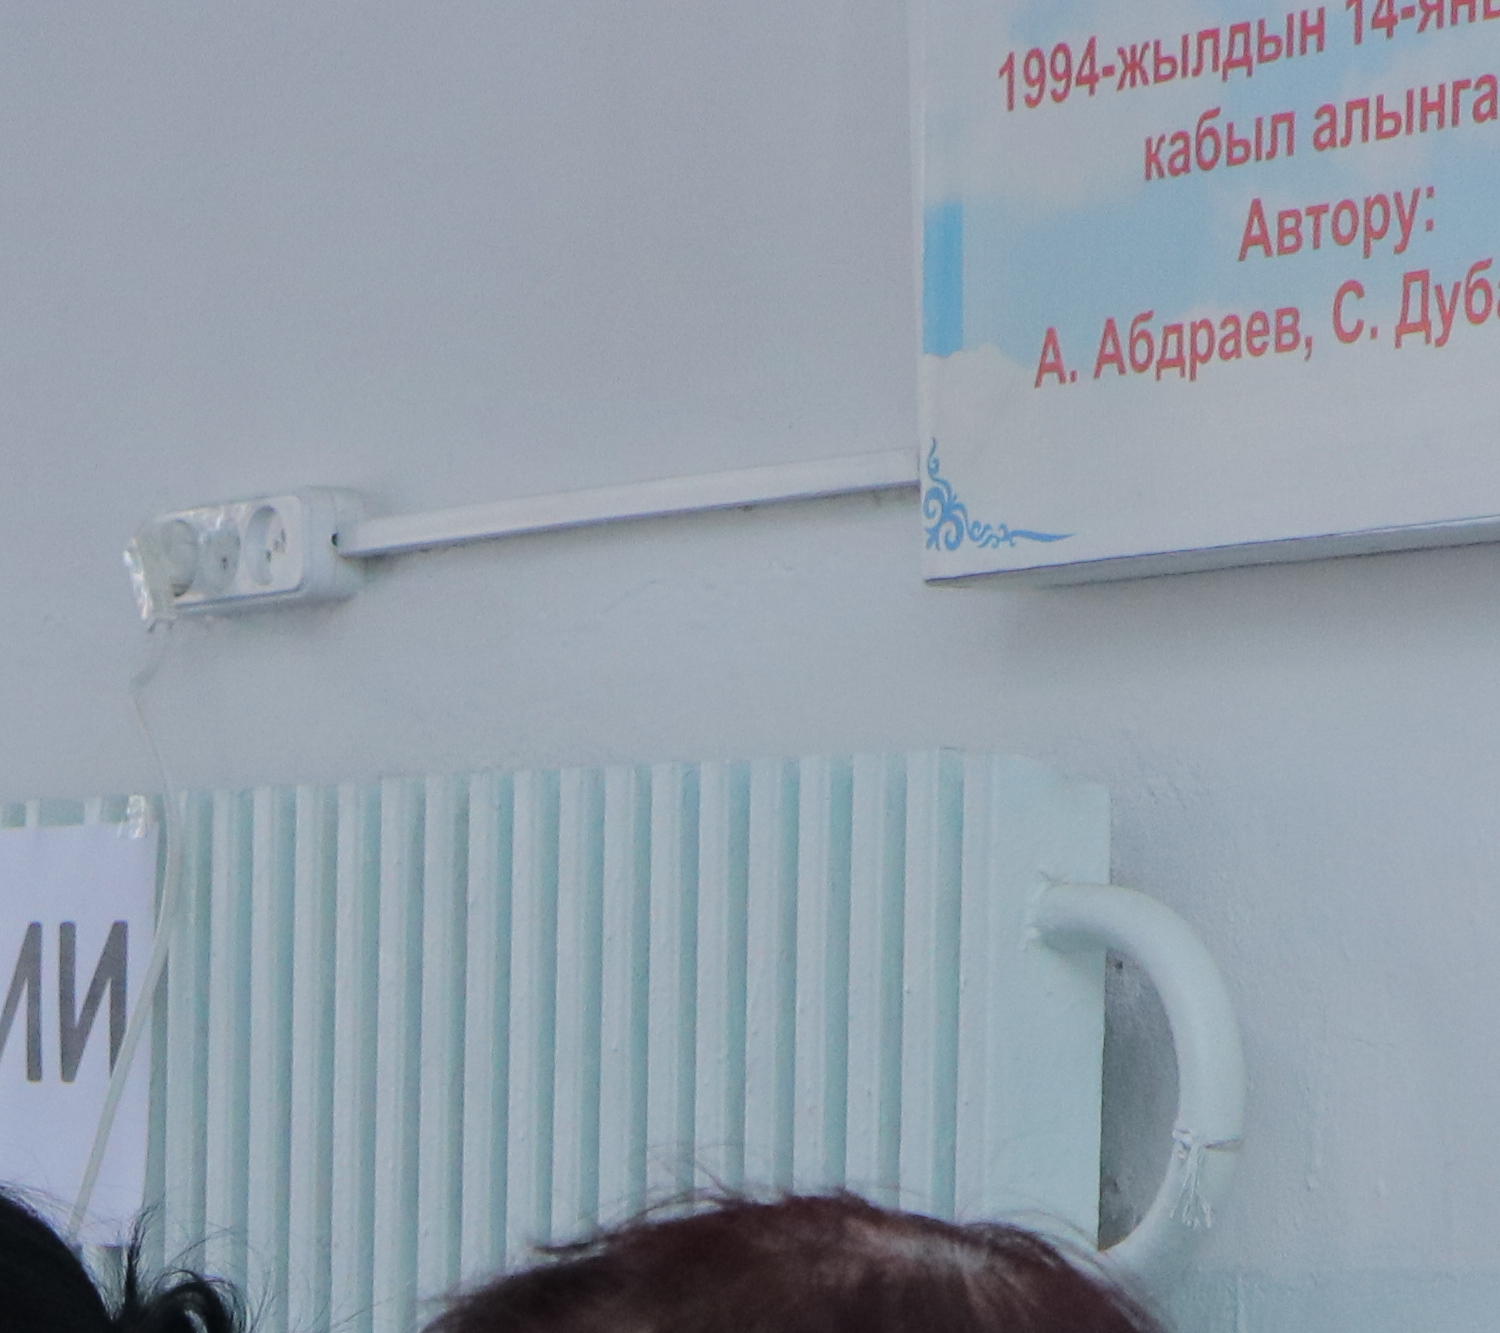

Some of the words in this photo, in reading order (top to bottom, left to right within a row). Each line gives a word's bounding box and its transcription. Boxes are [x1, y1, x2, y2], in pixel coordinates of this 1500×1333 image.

[998, 6, 1325, 112] 1994-жылдын
[1144, 107, 1297, 181] кабыл
[1237, 184, 1436, 261] Автору:
[1034, 326, 1078, 388] А.
[1093, 304, 1314, 381] Абдраев,
[1332, 279, 1379, 345] С.
